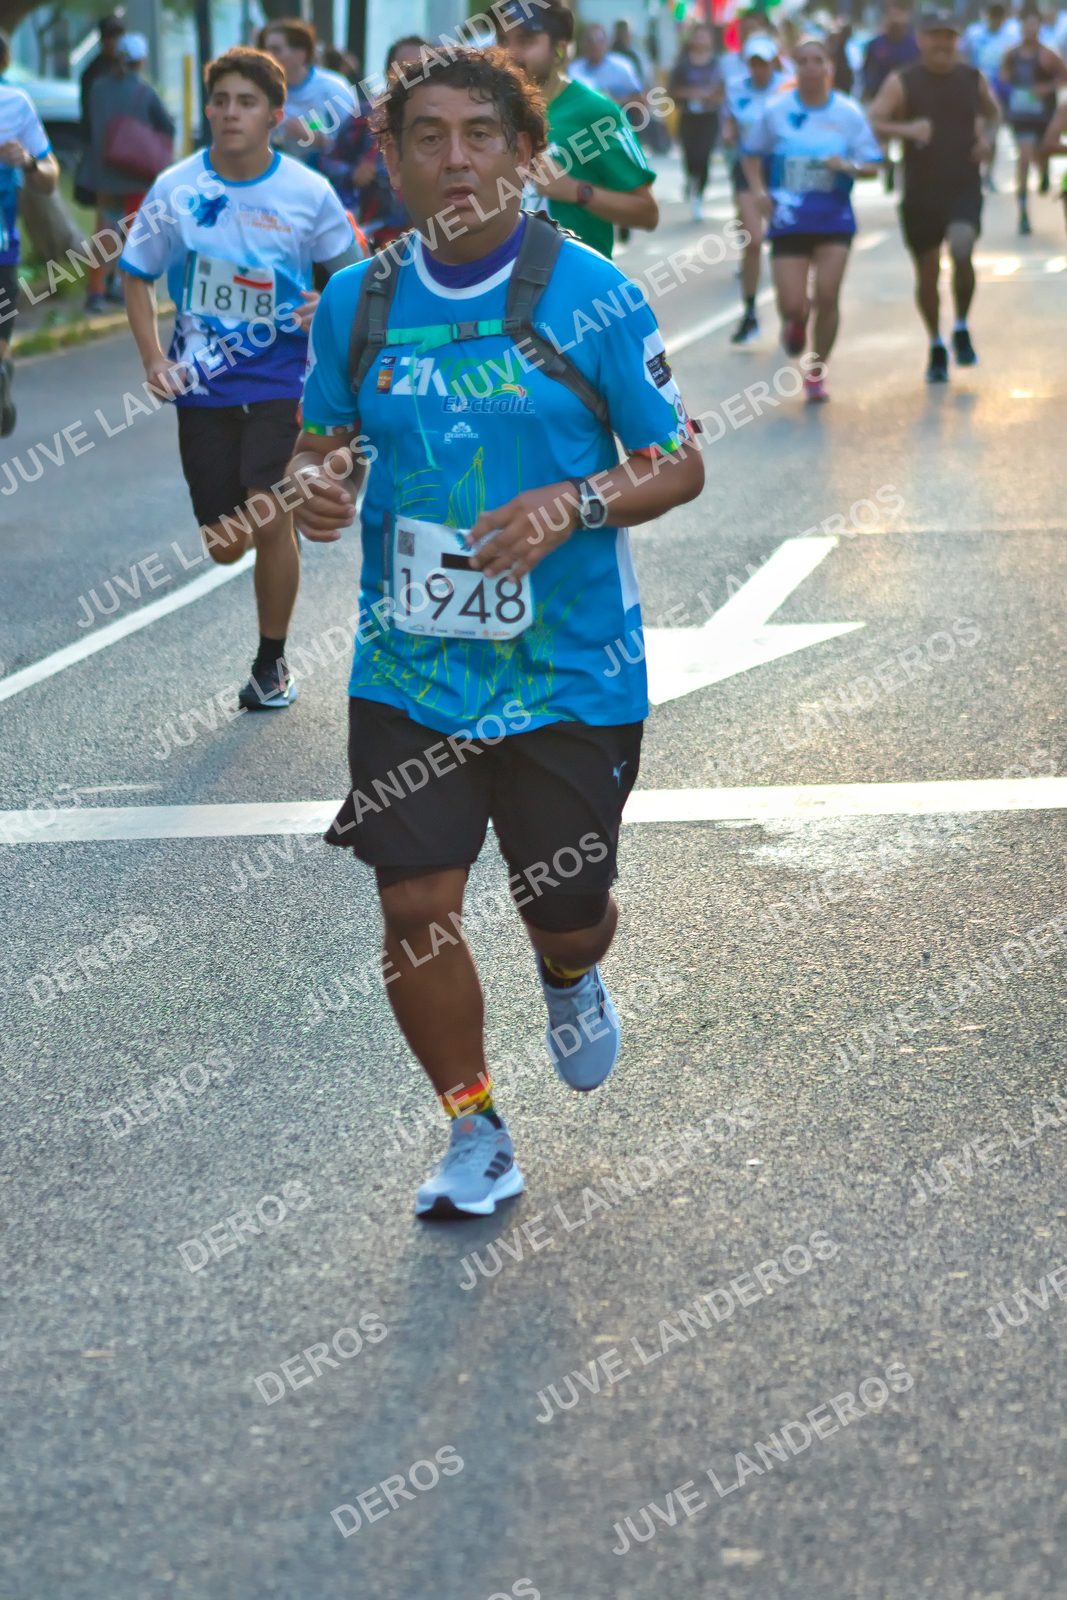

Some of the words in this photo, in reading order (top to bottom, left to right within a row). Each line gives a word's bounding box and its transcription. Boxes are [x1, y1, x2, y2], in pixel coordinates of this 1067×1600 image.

[199, 280, 272, 317] 1818
[442, 394, 535, 414] Electrolit
[401, 567, 526, 624] 1948
